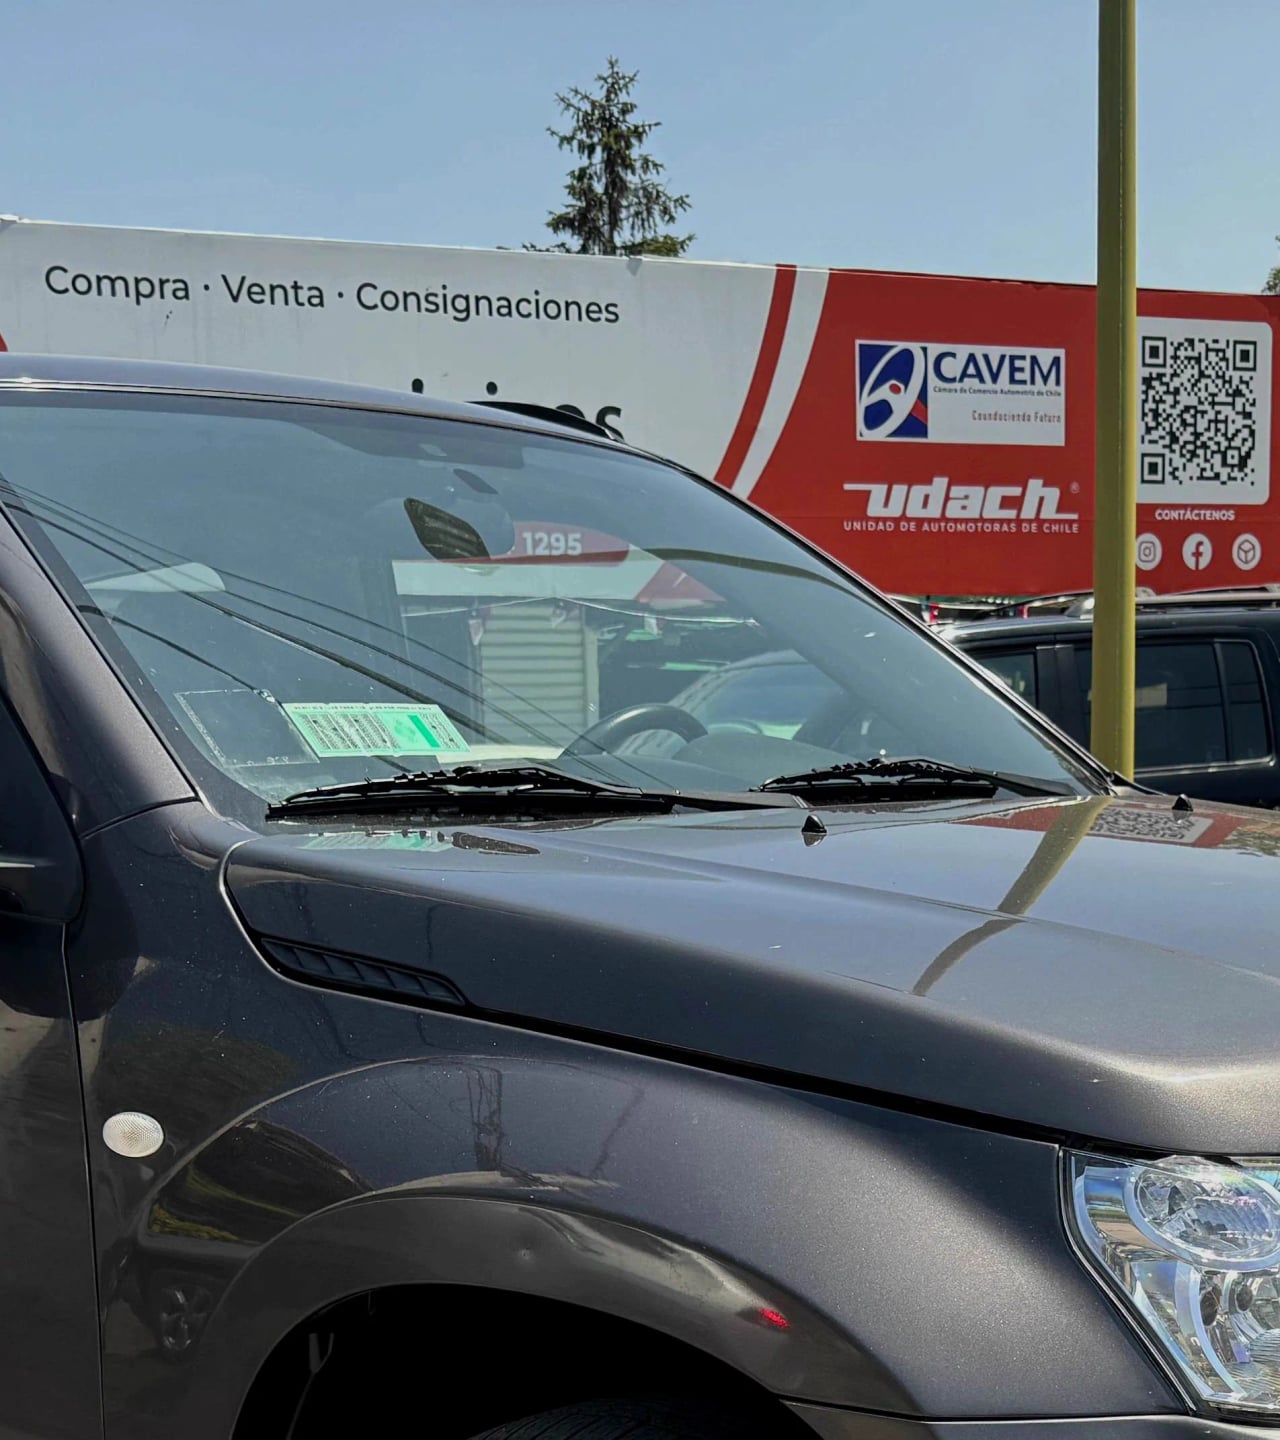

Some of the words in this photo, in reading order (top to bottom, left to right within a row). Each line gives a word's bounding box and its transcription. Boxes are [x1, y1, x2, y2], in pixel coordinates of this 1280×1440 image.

[44, 265, 190, 307] Compra
[220, 273, 325, 308] Venta
[356, 282, 620, 324] Consignaciones
[932, 351, 1061, 387] CAVEM
[843, 477, 1079, 520] udach
[1154, 507, 1236, 521] CONTÁCTENOS
[522, 530, 582, 556] 1295
[843, 521, 895, 532] UNIDAD
[900, 522, 916, 532] DE
[922, 522, 1017, 533] AUTOMOTORAS
[1021, 523, 1038, 533] DE
[1043, 523, 1079, 534] CHILE
